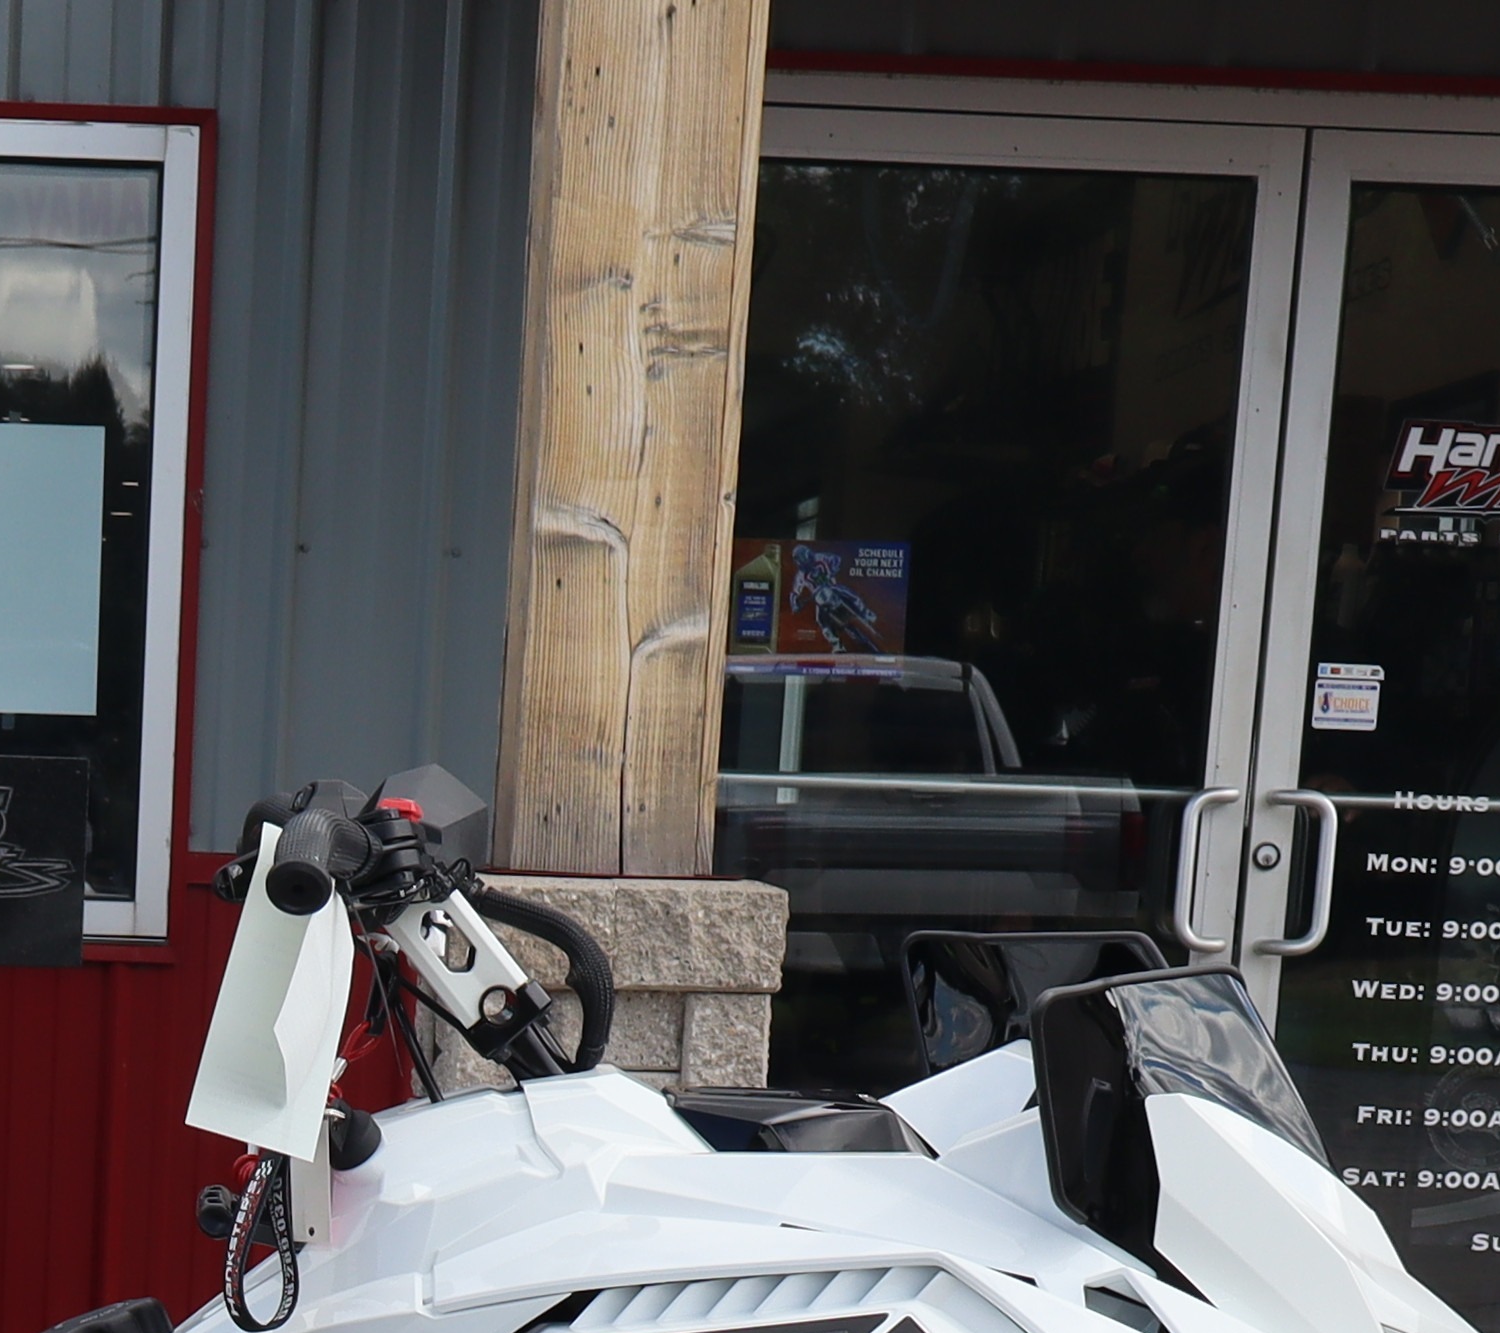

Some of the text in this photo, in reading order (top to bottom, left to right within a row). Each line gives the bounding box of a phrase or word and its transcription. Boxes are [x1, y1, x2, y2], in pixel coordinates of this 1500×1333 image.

[1380, 528, 1480, 546] PARTS
[854, 558, 903, 568] YOUR NEXT
[858, 548, 904, 559] SCHEDULE
[849, 567, 903, 578] OIL CHANGE
[1394, 791, 1489, 813] HOURS
[1367, 853, 1438, 874] MON:
[1367, 917, 1431, 938] TUE:
[1352, 979, 1425, 1002] WED:
[1352, 1043, 1418, 1064] THU:
[1357, 1105, 1413, 1127] FRI:
[1343, 1167, 1406, 1189] SAT:
